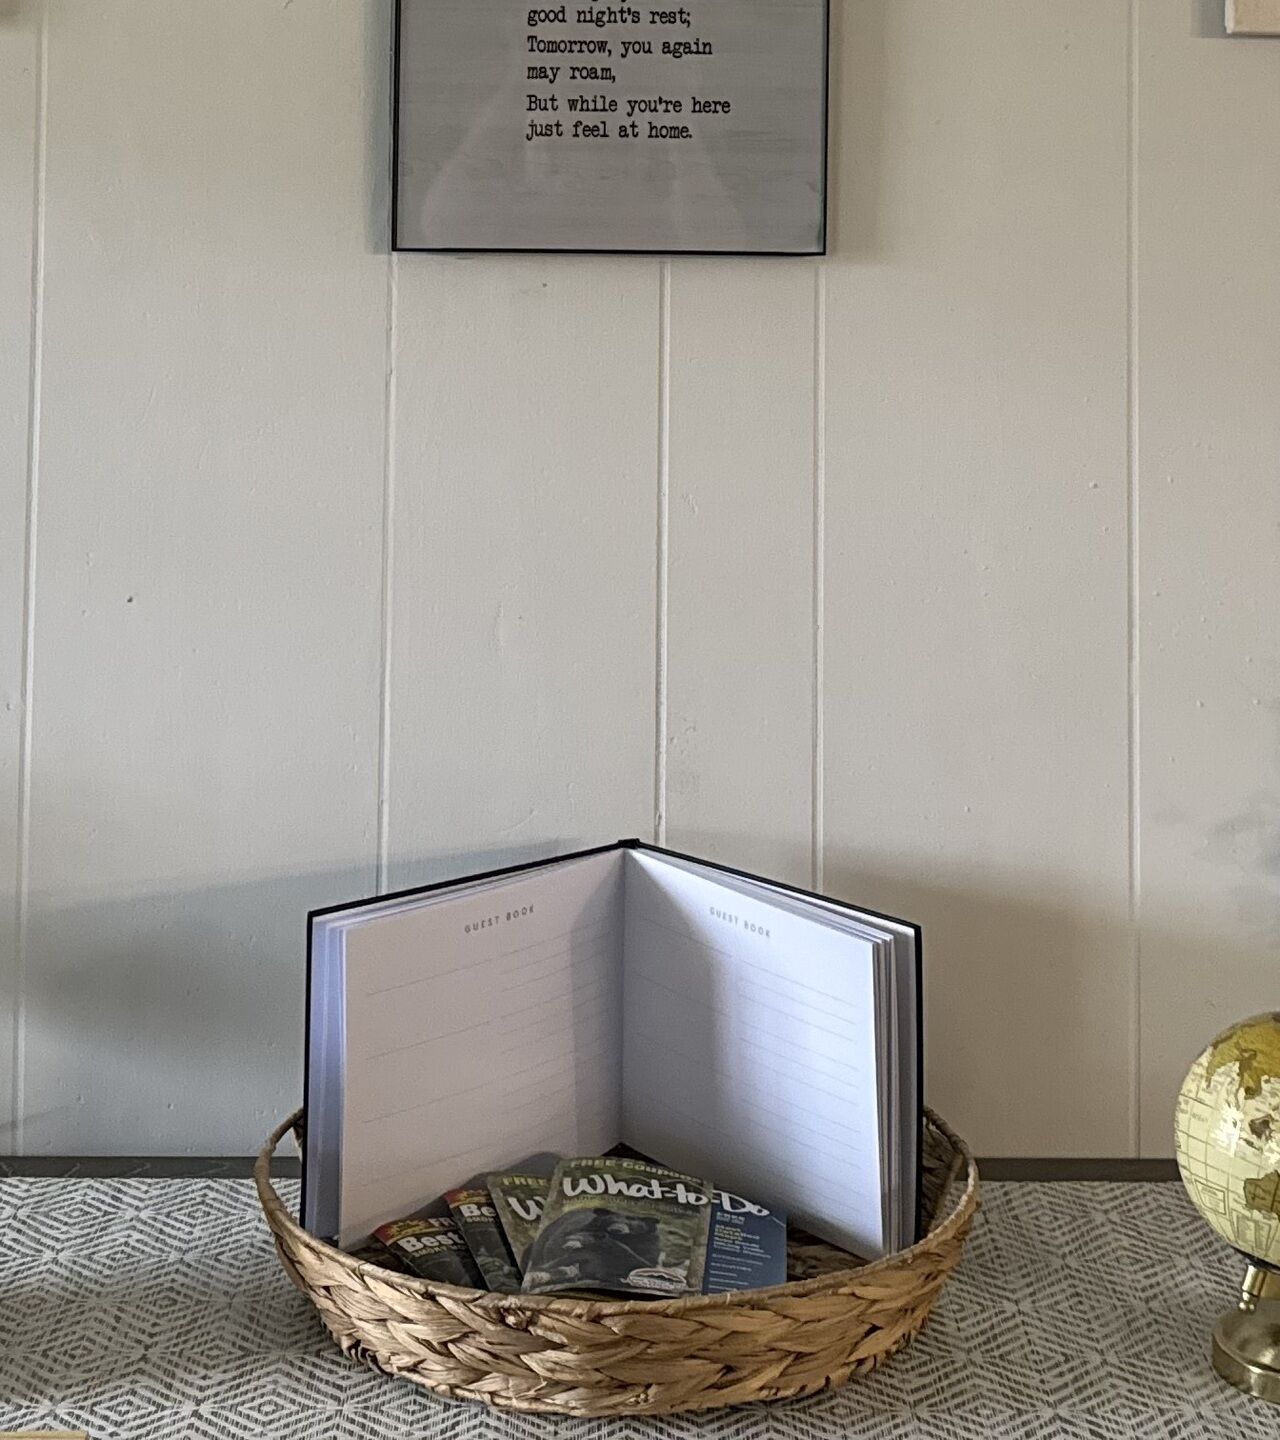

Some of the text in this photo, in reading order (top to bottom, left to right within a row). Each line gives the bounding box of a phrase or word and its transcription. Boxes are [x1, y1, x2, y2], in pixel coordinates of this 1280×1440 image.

[527, 5, 691, 29] good night's rest;
[526, 34, 713, 59] Tomorrow, you again
[526, 66, 616, 85] may roam,
[525, 93, 731, 118] But while you're here
[525, 119, 693, 142] just feel at home.
[464, 904, 534, 933] GUEST BOOK
[709, 906, 770, 937] GUEST BOOK
[397, 1231, 466, 1252] Best
